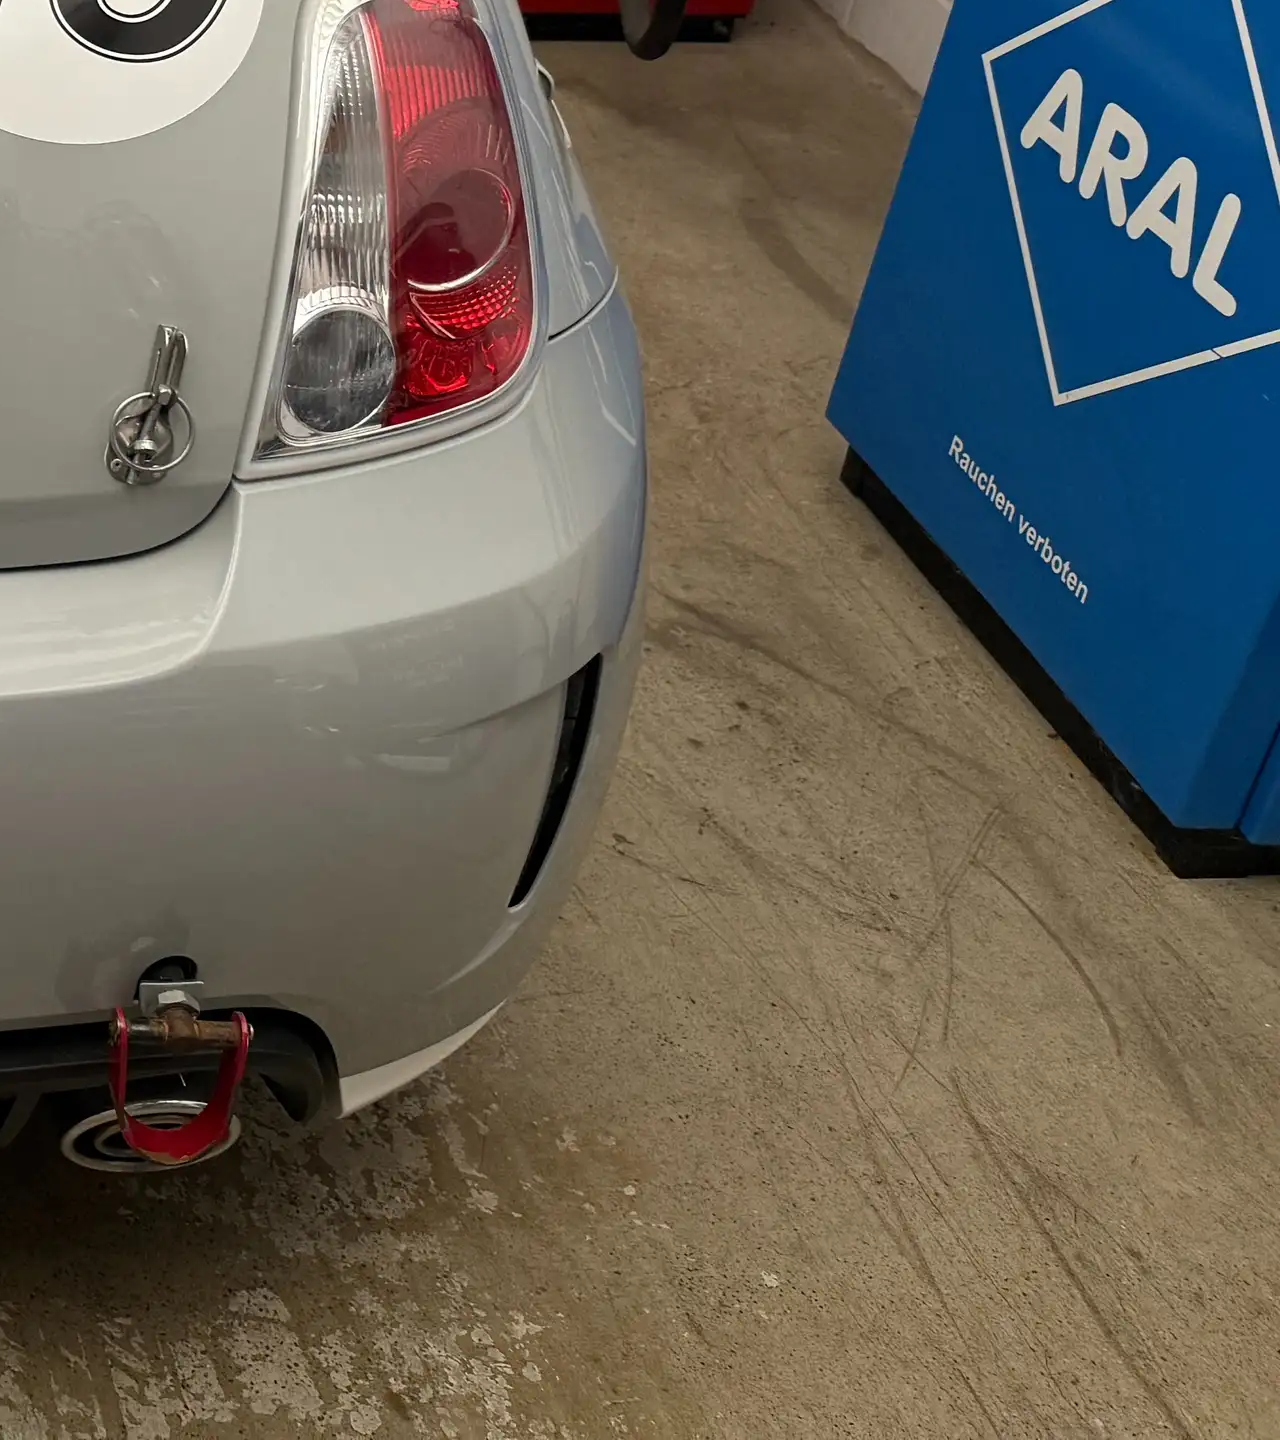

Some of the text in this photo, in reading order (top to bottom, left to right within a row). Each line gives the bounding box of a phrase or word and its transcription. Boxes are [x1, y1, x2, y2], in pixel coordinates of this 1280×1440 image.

[1020, 68, 1242, 317] ARAL
[948, 434, 1089, 604] Rauchen verboten
